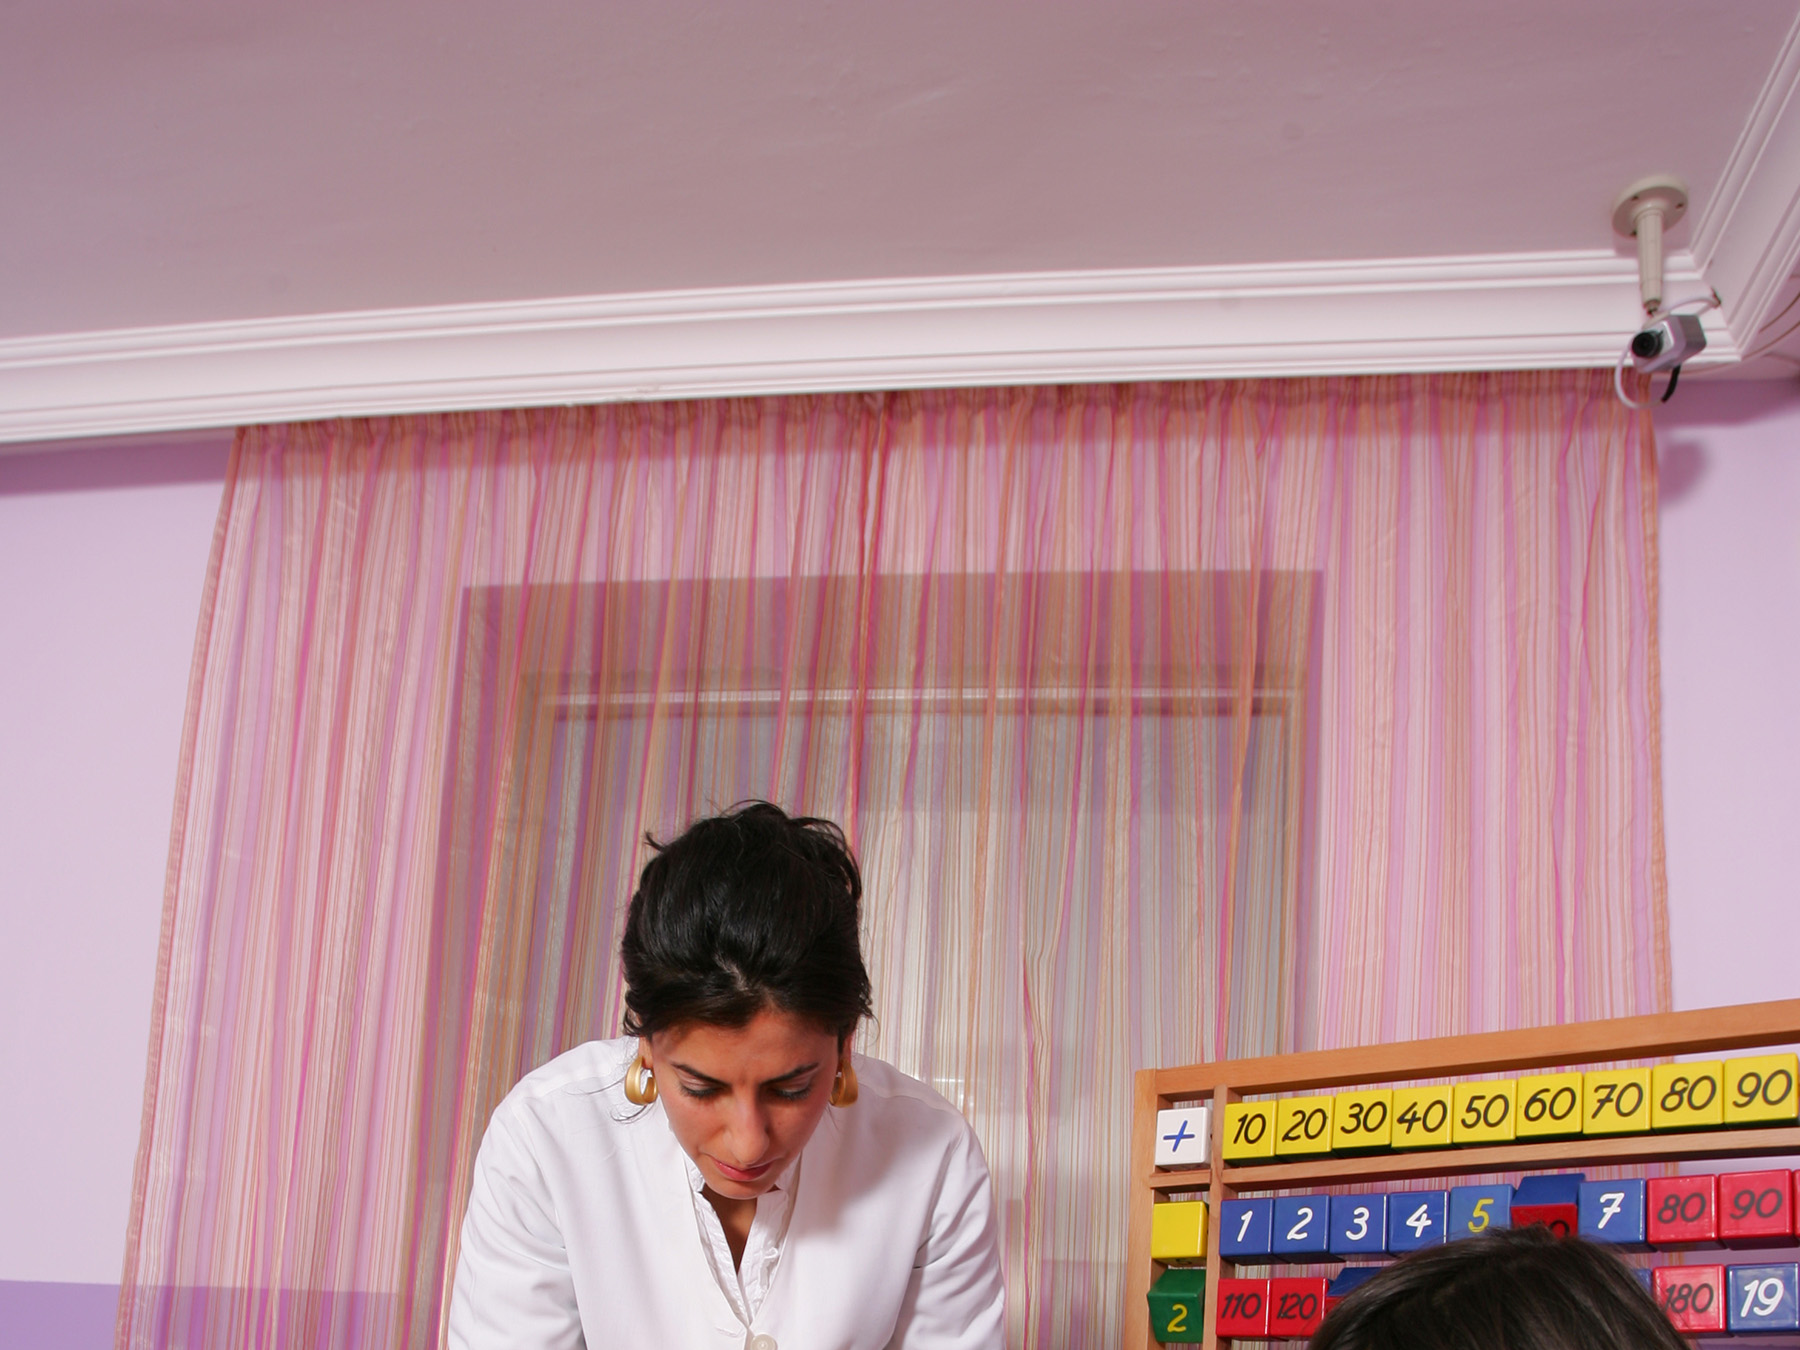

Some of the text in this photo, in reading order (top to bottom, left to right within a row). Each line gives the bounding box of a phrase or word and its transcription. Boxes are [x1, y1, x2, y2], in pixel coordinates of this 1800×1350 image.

[1233, 1069, 1793, 1144] 10 20 30 40 50 60 70 80 90
[1237, 1198, 1494, 1242] 1 2 3 4 5
[1598, 1192, 1625, 1229] 7
[1657, 1193, 1706, 1224] 80
[1730, 1188, 1782, 1220] 90
[1221, 1293, 1318, 1320] 110 120
[1664, 1277, 1784, 1317] 180 19
[1167, 1304, 1187, 1332] 2
